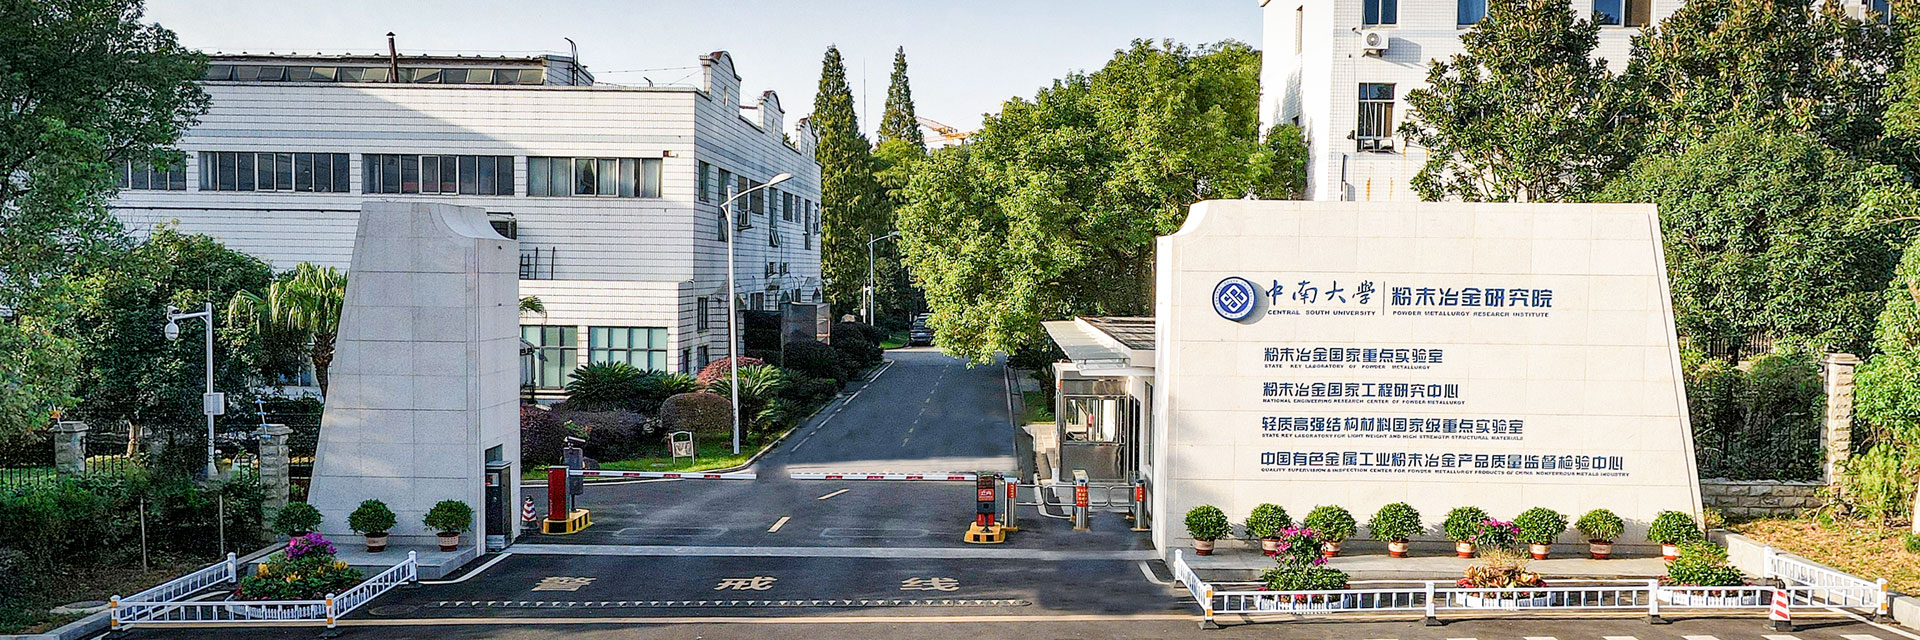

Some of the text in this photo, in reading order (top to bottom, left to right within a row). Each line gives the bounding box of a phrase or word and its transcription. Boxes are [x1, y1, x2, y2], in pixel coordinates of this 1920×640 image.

[1391, 287, 1552, 307] 粉末冶金研究院
[1264, 347, 1443, 363] 粉末冶金国家重点实验室
[1263, 382, 1458, 398] 粉末冶金国家工程研究中心
[1262, 417, 1523, 434] 轻质高强结构材料国家级重点实验室
